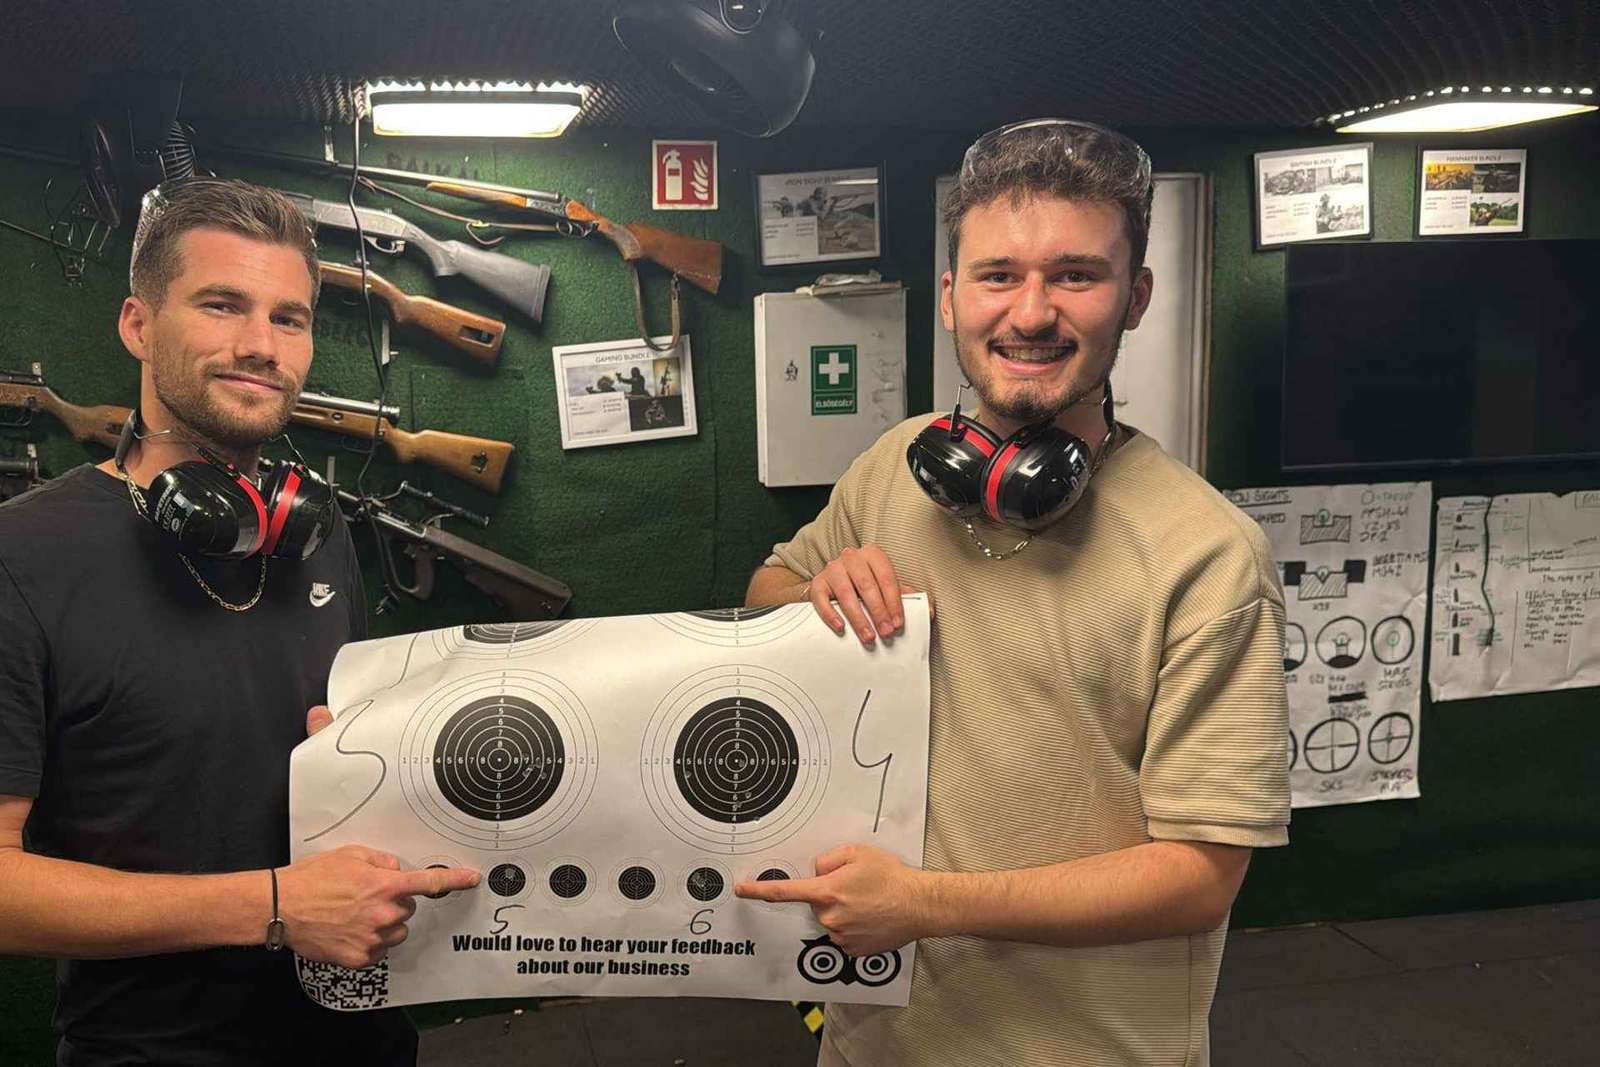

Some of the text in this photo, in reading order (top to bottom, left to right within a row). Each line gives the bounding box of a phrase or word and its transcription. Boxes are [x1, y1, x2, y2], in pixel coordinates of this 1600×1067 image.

[489, 904, 526, 935] 5
[690, 908, 715, 936] 6
[452, 935, 756, 955] Would love to hear your feedback
[517, 959, 690, 976] about our business
